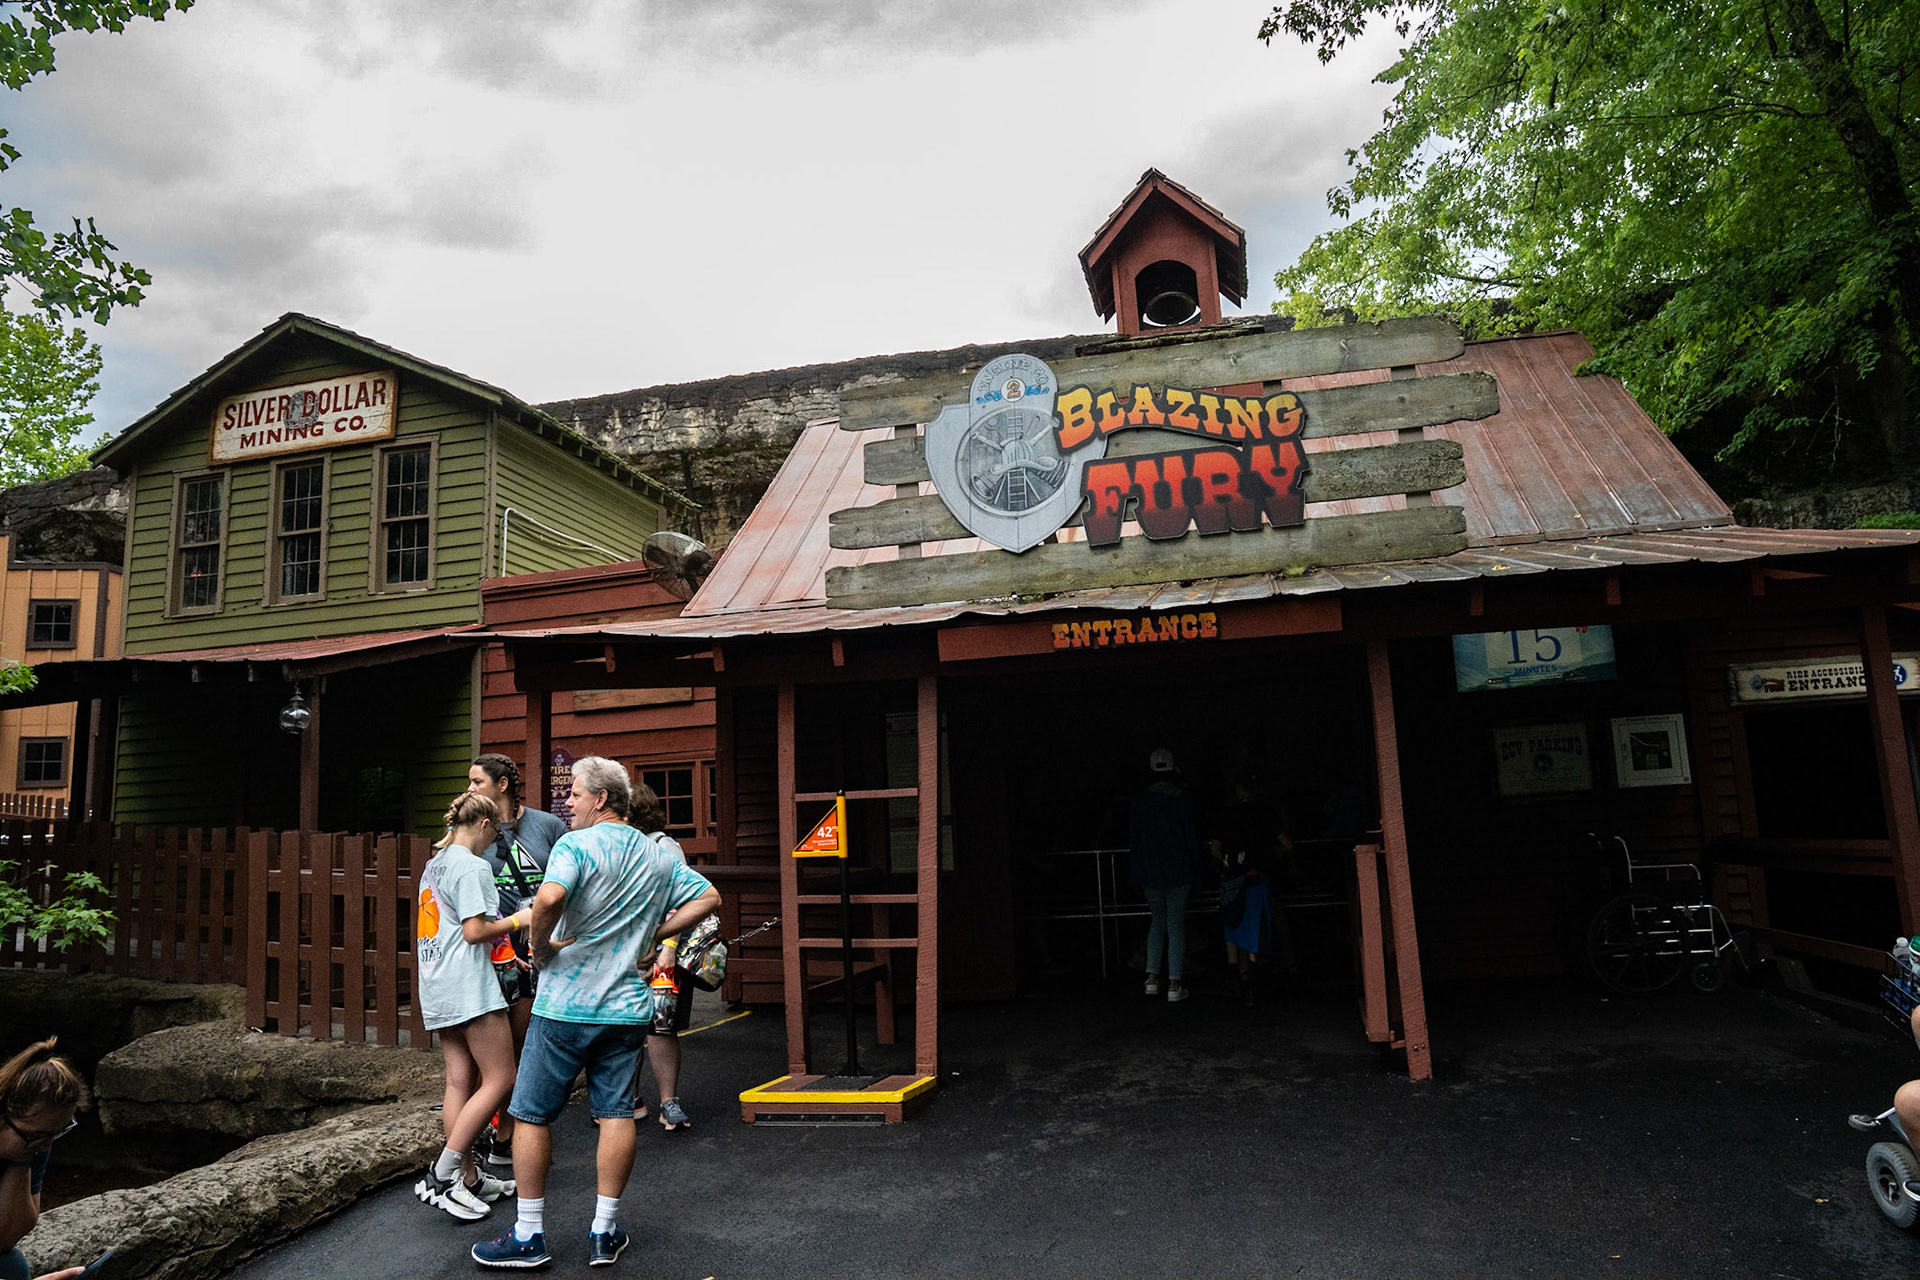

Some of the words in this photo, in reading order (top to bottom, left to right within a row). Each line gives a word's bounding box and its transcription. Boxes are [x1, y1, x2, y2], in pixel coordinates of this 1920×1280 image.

[979, 359, 1031, 392] ENGINE
[1006, 380, 1021, 400] 2
[223, 394, 291, 431] SILVER
[302, 378, 387, 418] DOLLAR
[1056, 386, 1303, 449] BLAZING
[240, 422, 324, 449] MINING
[334, 415, 368, 433] CO.
[1087, 440, 1303, 547] FURY
[1051, 612, 1218, 650] ENTRANCE
[1514, 664, 1558, 675] MINUTES
[1786, 670, 1809, 679] RIDE
[1811, 666, 1865, 678] ACCESSIBIL
[1788, 676, 1869, 692] ENTRANC
[1529, 736, 1584, 756] PARKING
